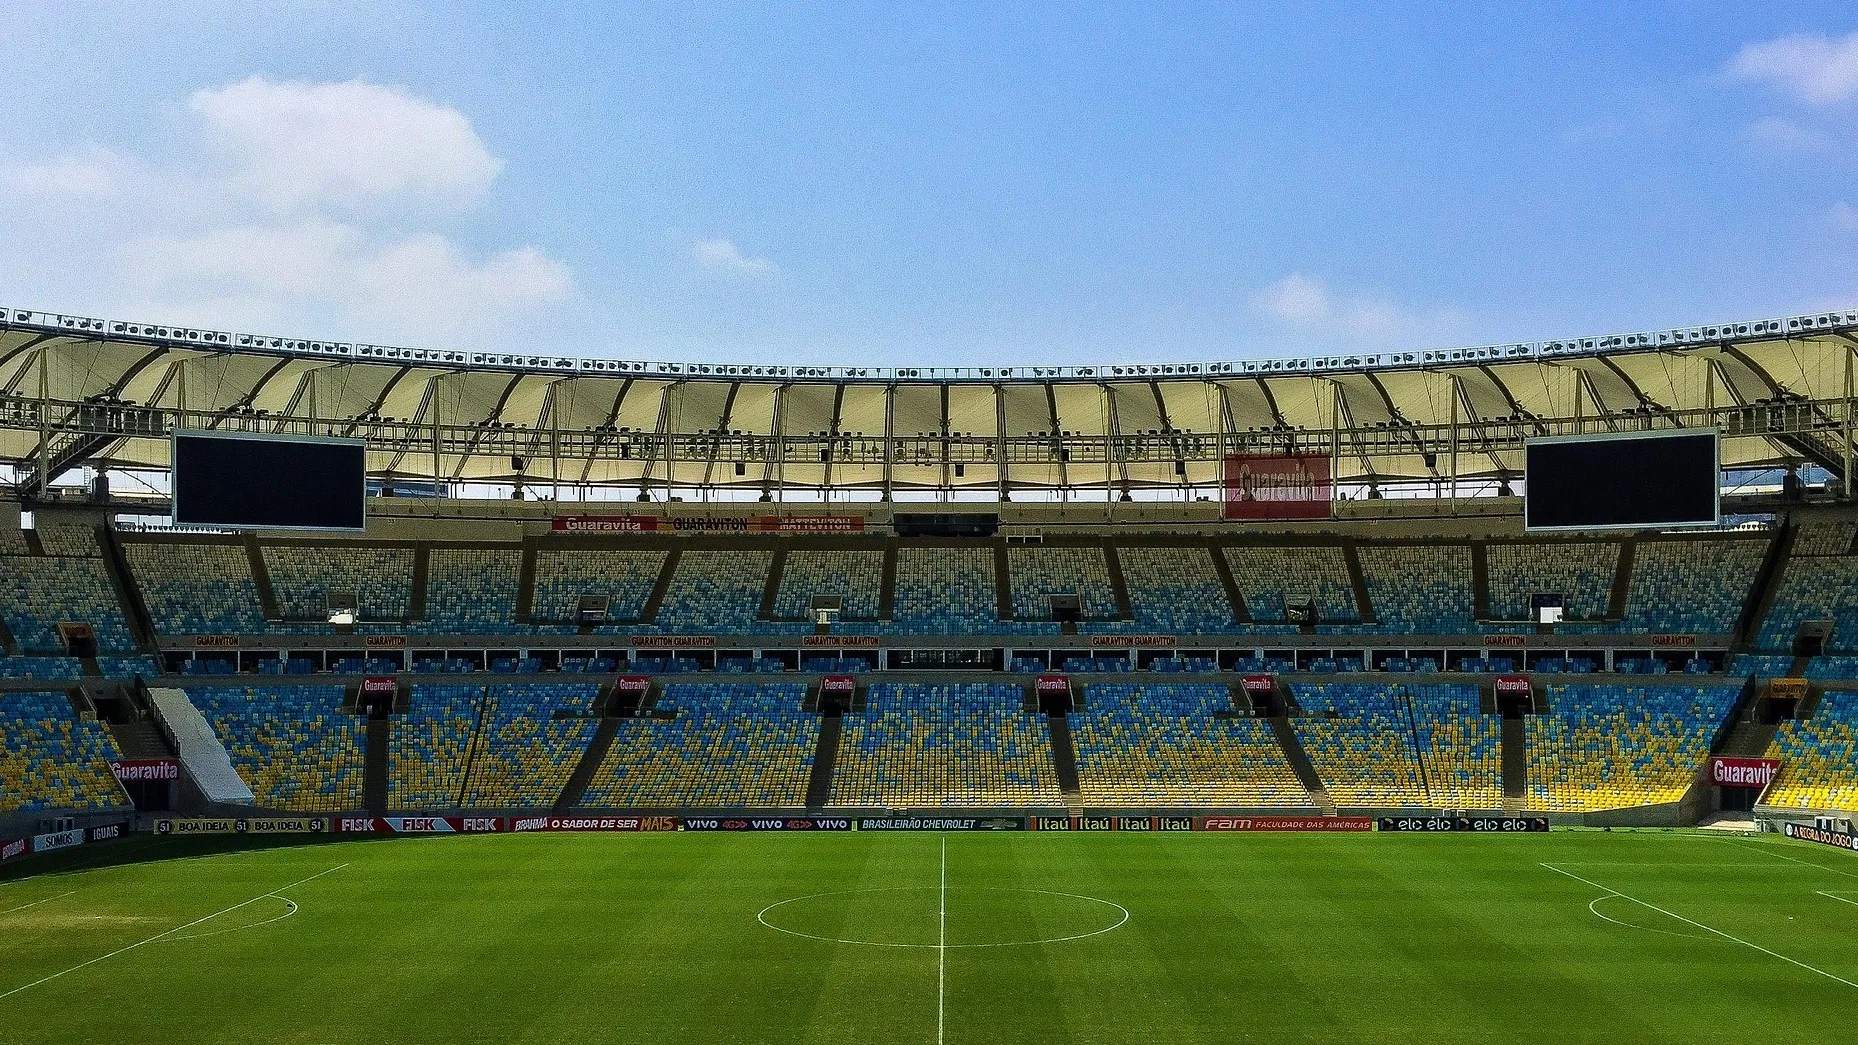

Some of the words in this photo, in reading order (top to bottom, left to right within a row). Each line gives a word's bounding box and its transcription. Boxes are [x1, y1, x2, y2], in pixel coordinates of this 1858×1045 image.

[565, 518, 641, 531] Guaravita
[672, 517, 749, 531] GUARAVITON
[196, 636, 239, 646] GUARAVITON
[366, 636, 407, 646] GUARAVITON
[631, 636, 672, 646] GUARAVITON
[674, 636, 715, 646] GUARAVITON
[803, 636, 840, 646] GUARAVITON
[842, 636, 879, 646] GUARAVITON
[1092, 636, 1134, 646] GUARAVITON
[1134, 636, 1176, 646] GUARAVITON
[1484, 636, 1525, 646] GUARAVITON
[1652, 636, 1696, 646] GUARAVITON
[824, 678, 853, 690] Guaravita
[1037, 678, 1066, 690] Guaravita
[1497, 678, 1528, 690] Guaravita
[112, 761, 178, 780] Guaravita
[159, 823, 171, 832] 51
[179, 822, 200, 831] BOA
[202, 822, 229, 831] IDEIA
[236, 821, 248, 831] 51
[255, 822, 276, 831] BOA
[278, 821, 303, 830] IDEIA
[310, 820, 322, 830] 51
[341, 818, 375, 832] FISK
[402, 818, 437, 831] FISK
[463, 818, 497, 831] FISK
[515, 817, 548, 832] BRAHMA
[551, 820, 560, 828] O
[561, 820, 598, 829] SABOR
[600, 820, 615, 828] DE
[616, 820, 638, 828] SER
[640, 817, 674, 831] MAIS
[687, 820, 718, 829] VIVO
[752, 820, 783, 829] VIVO
[817, 820, 847, 829] VIVO
[862, 817, 921, 830] BRASILEIRÃO
[922, 819, 976, 830] CHEVROLET
[1038, 817, 1069, 830] Itaú
[1079, 817, 1109, 830] Itaú
[1120, 817, 1150, 830] Itaú
[1160, 817, 1190, 830] Itaú
[1255, 821, 1304, 829] FACULDADE
[1327, 820, 1370, 829] AMÉRICAS
[93, 825, 119, 840] IGUAIS
[1793, 825, 1800, 837] A
[1800, 826, 1820, 842] REGRA
[1820, 830, 1831, 844] DO
[1831, 832, 1852, 848] JOGO
[45, 832, 73, 848] SOMOS
